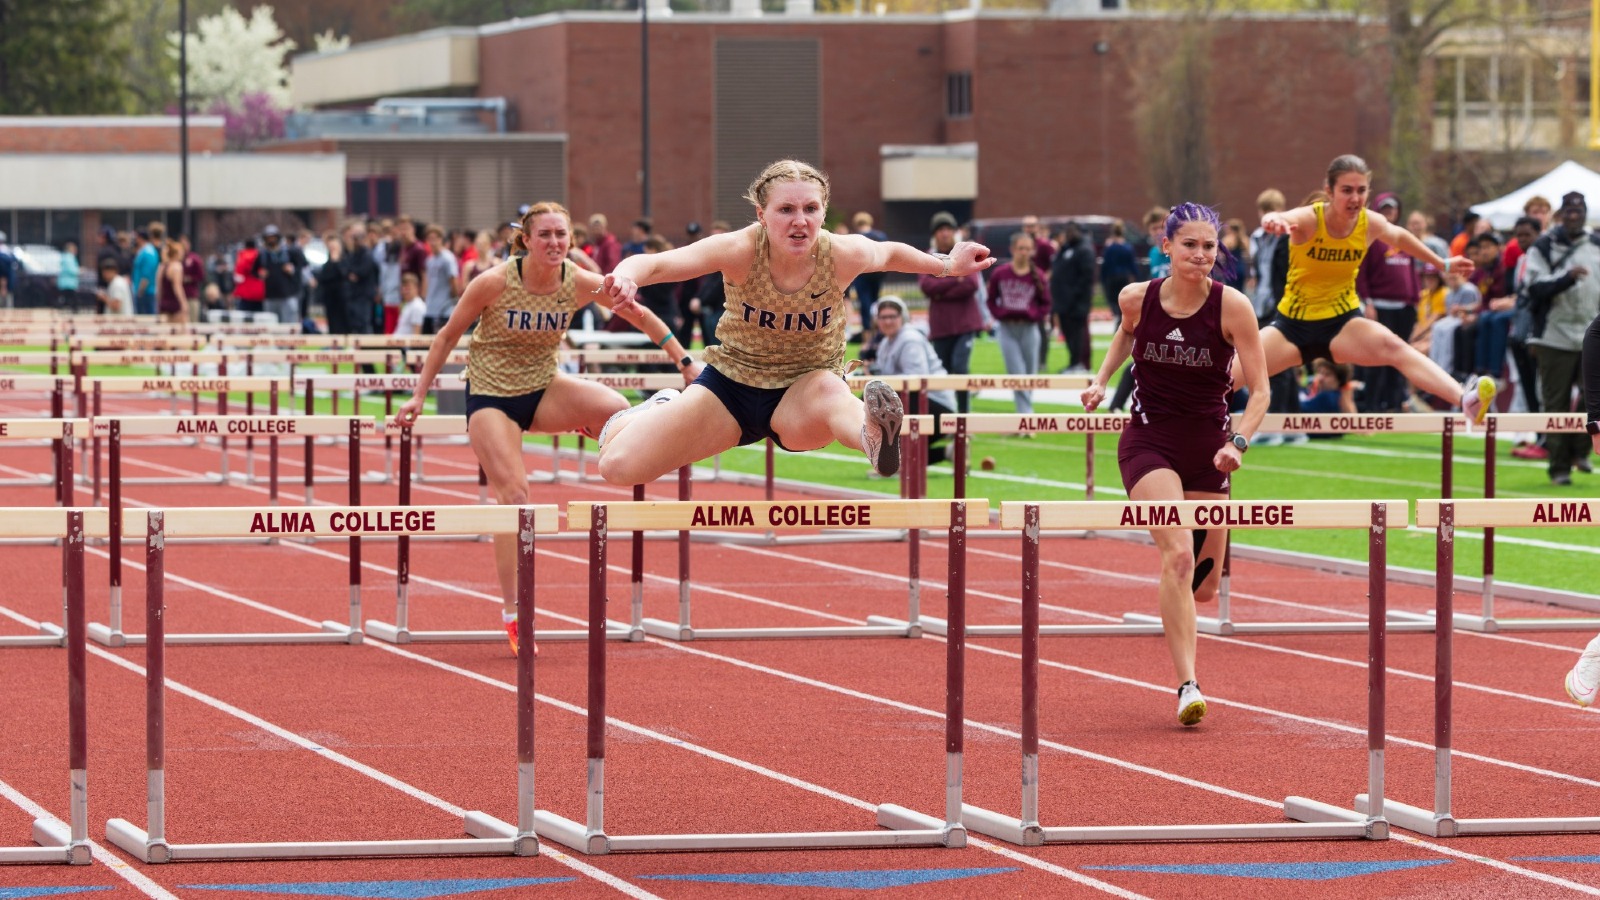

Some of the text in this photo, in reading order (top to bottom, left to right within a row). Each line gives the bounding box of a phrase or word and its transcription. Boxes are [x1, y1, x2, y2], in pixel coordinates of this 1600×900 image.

[1306, 246, 1363, 262] ADRIAN
[506, 310, 569, 331] TRINE
[742, 302, 832, 332] TRINE
[1143, 341, 1213, 367] ALMA
[142, 380, 231, 390] ALMA COLLEGE
[355, 378, 385, 388] ALMA
[967, 378, 1050, 389] ALMA COLLEGE
[176, 420, 297, 434] ALMA COLLEGE
[1018, 417, 1058, 431] ALMA
[1282, 416, 1394, 431] ALMA COLLEGE
[1546, 417, 1584, 430] ALMA
[691, 505, 871, 527] ALMA COLLEGE
[1120, 505, 1294, 526] ALMA COLLEGE
[1532, 502, 1592, 523] ALMA
[250, 511, 436, 533] ALMA COLLEGE
